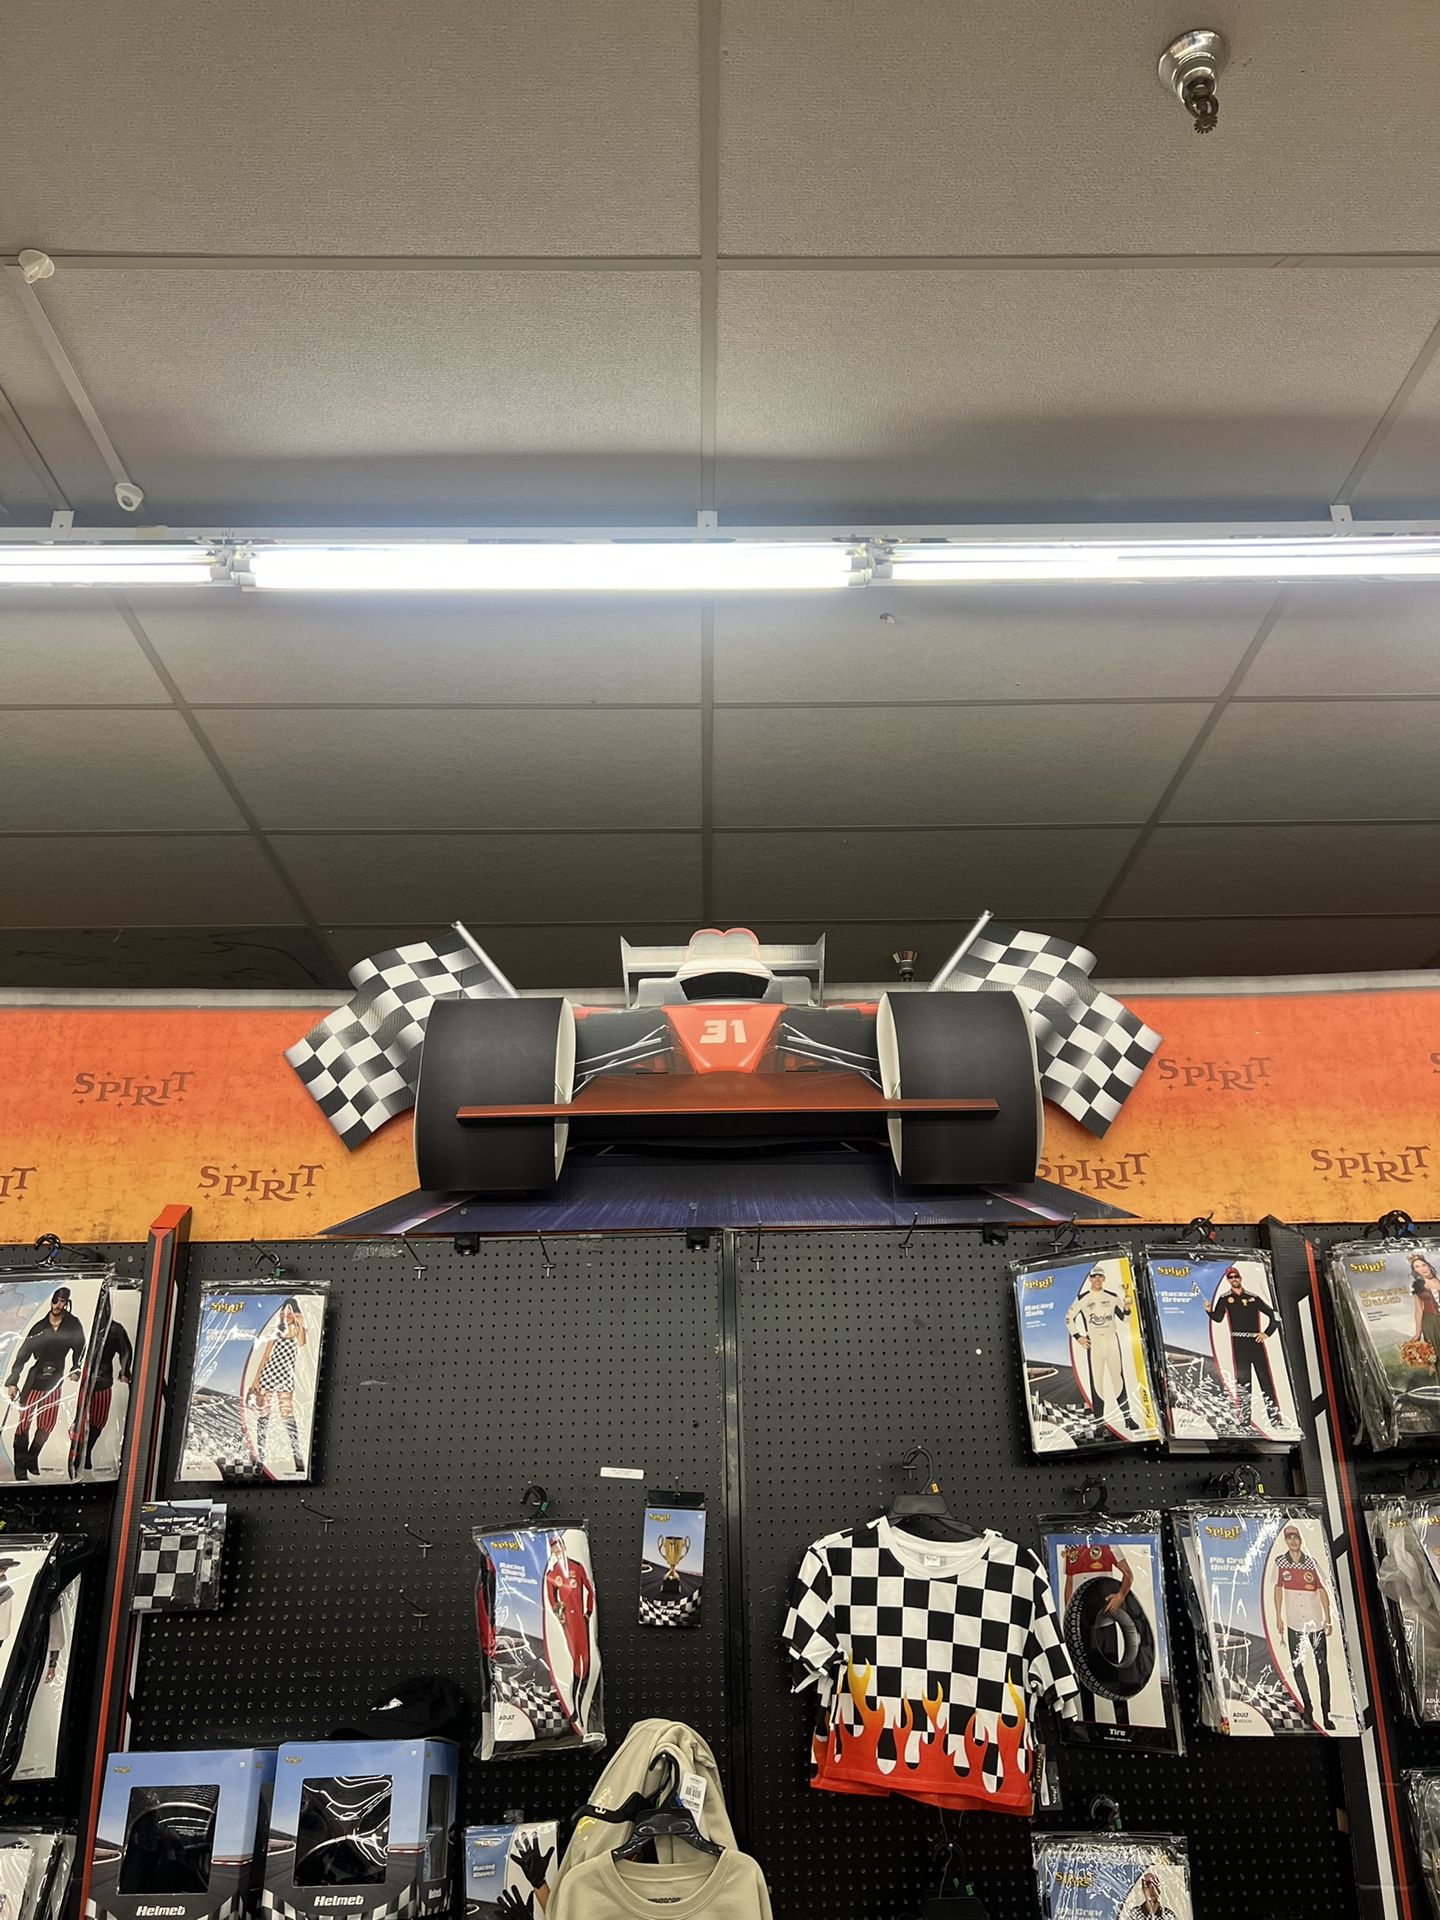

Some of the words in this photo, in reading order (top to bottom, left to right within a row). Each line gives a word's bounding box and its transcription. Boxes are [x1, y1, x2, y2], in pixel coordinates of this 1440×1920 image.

[699, 1019, 747, 1044] 31
[1157, 1056, 1274, 1092] SPIRIT
[72, 1070, 196, 1107] SPIRIT
[1310, 1145, 1432, 1183] SPIRIT
[197, 1163, 325, 1202] SPIRIT
[1157, 1265, 1192, 1278] SPIRIT
[1348, 1259, 1386, 1273] SPIRIT
[1024, 1301, 1054, 1312] Racing
[1205, 1525, 1241, 1539] SPIRIT
[1226, 1556, 1250, 1565] Cre
[1109, 1728, 1126, 1736] Tire
[313, 1894, 364, 1907] Helmet
[135, 1905, 186, 1917] Helmet
